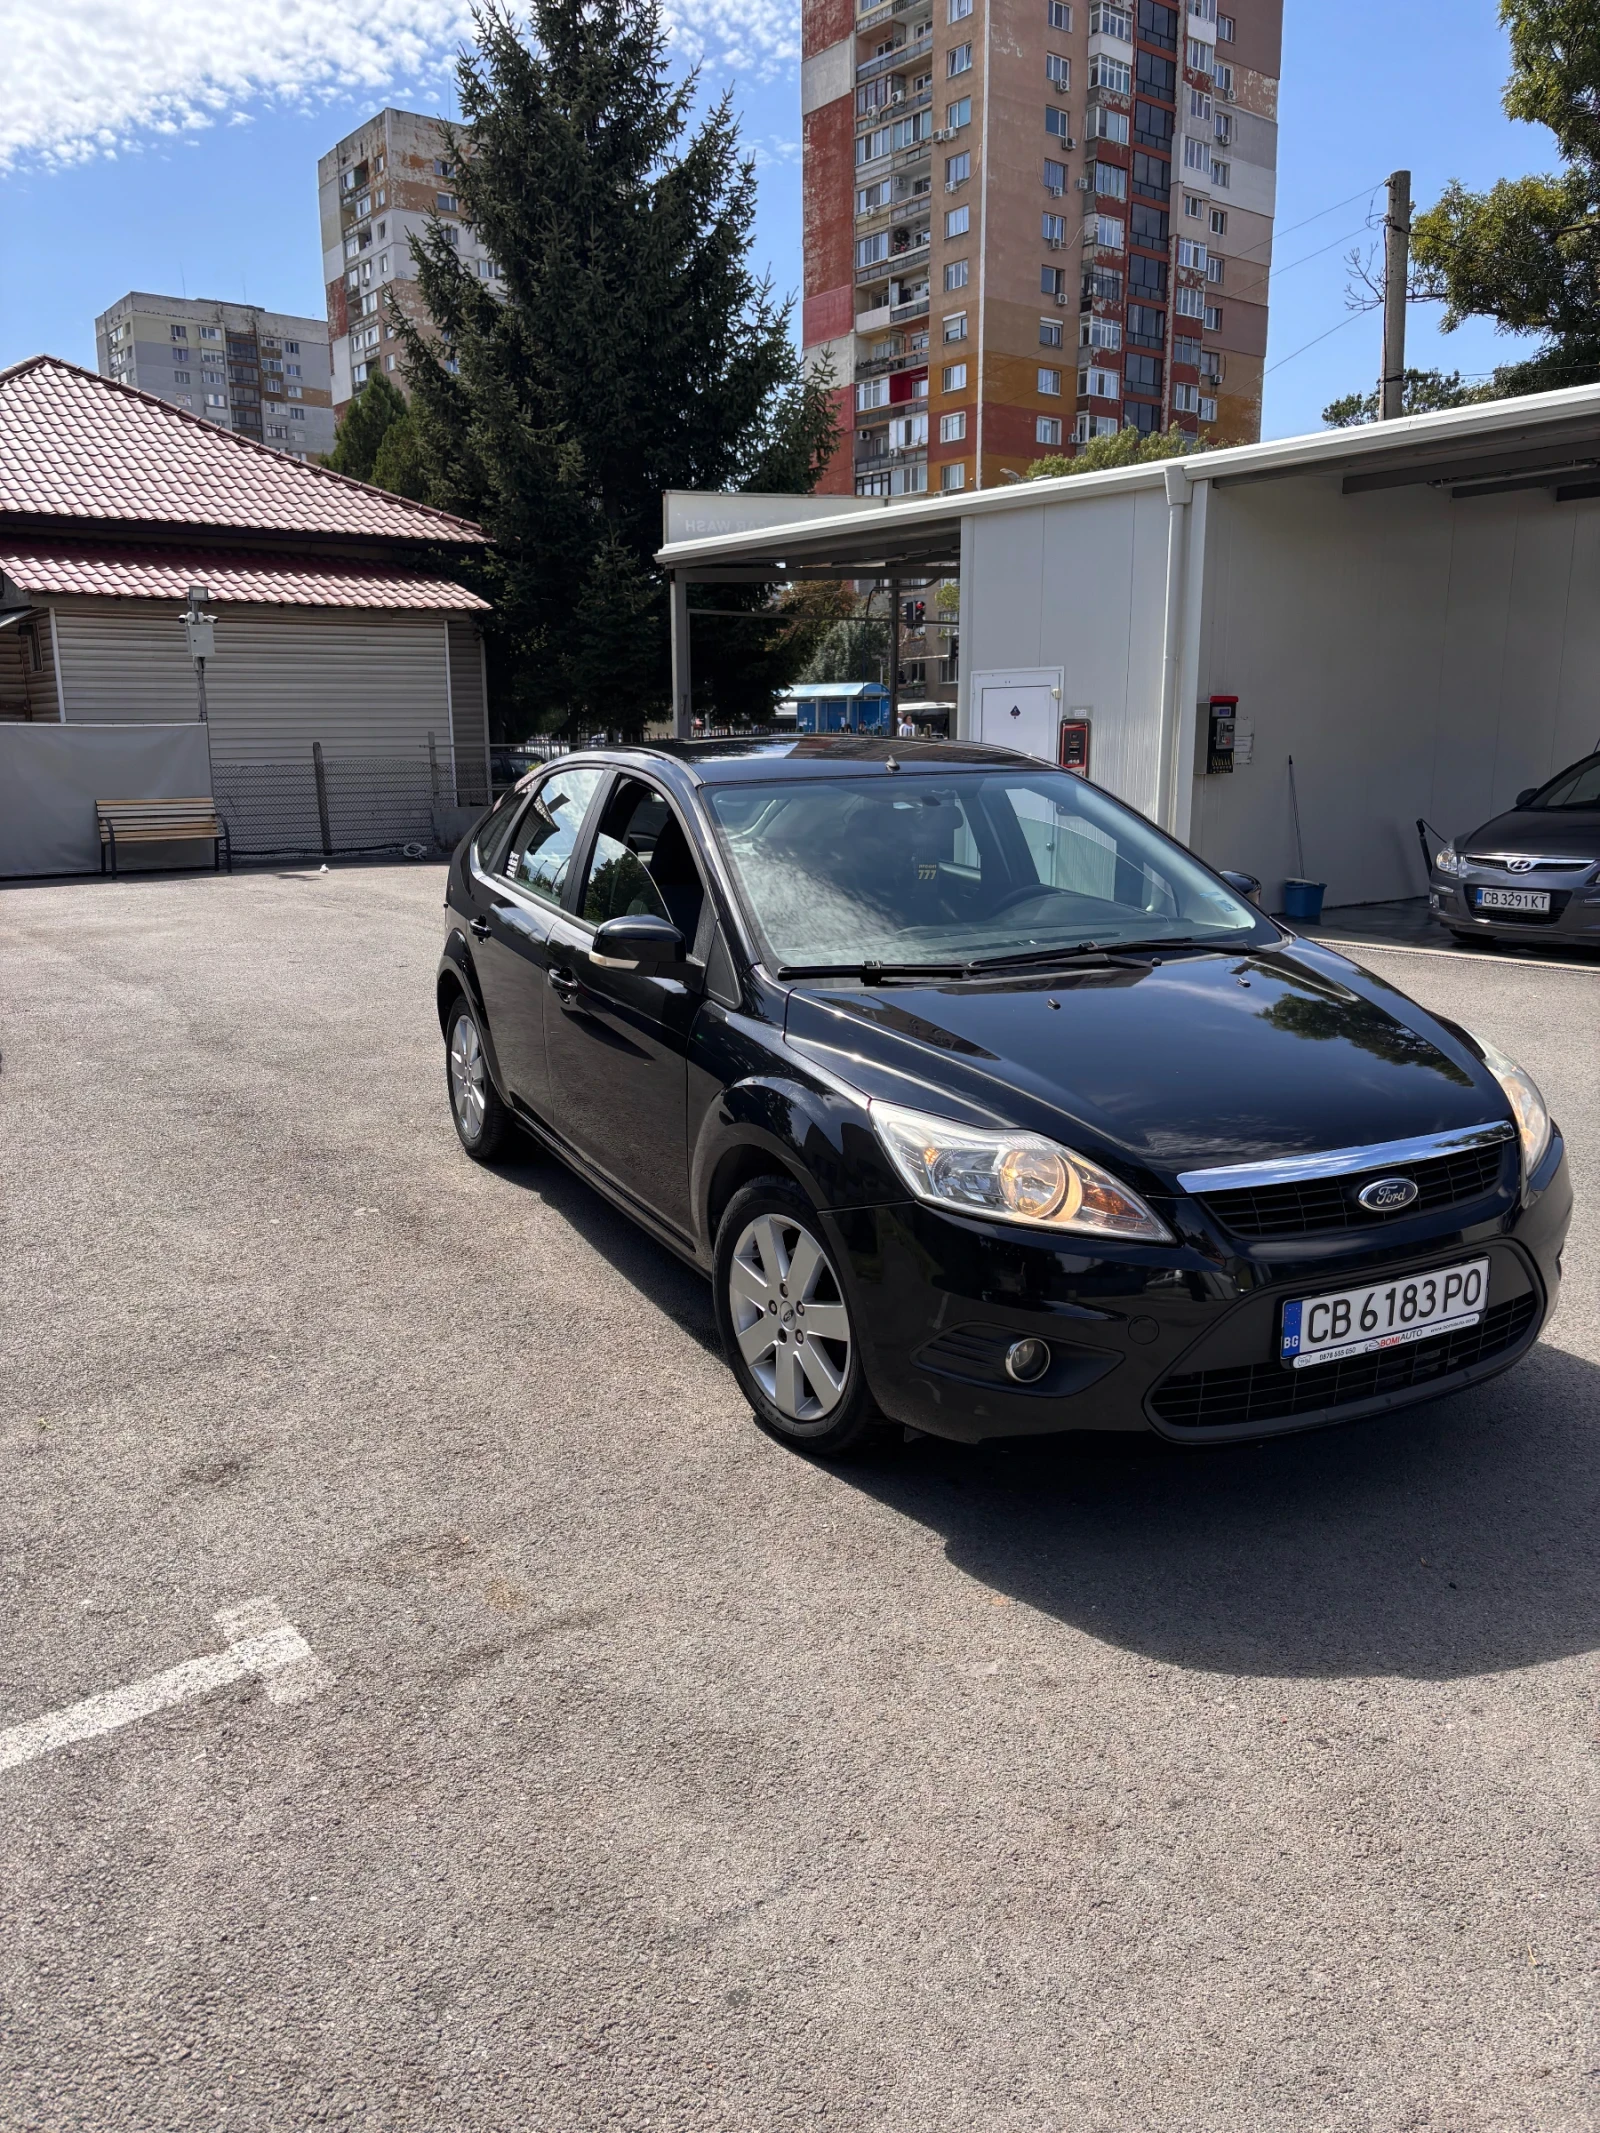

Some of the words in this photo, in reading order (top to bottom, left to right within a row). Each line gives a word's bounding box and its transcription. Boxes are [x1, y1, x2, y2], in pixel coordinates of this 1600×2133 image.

[918, 869, 937, 880] 777
[1500, 893, 1528, 908] 3291
[1376, 1185, 1406, 1205] Ford
[1308, 1299, 1351, 1344] CB
[1359, 1279, 1437, 1332] 6183
[1283, 1335, 1299, 1349] BG
